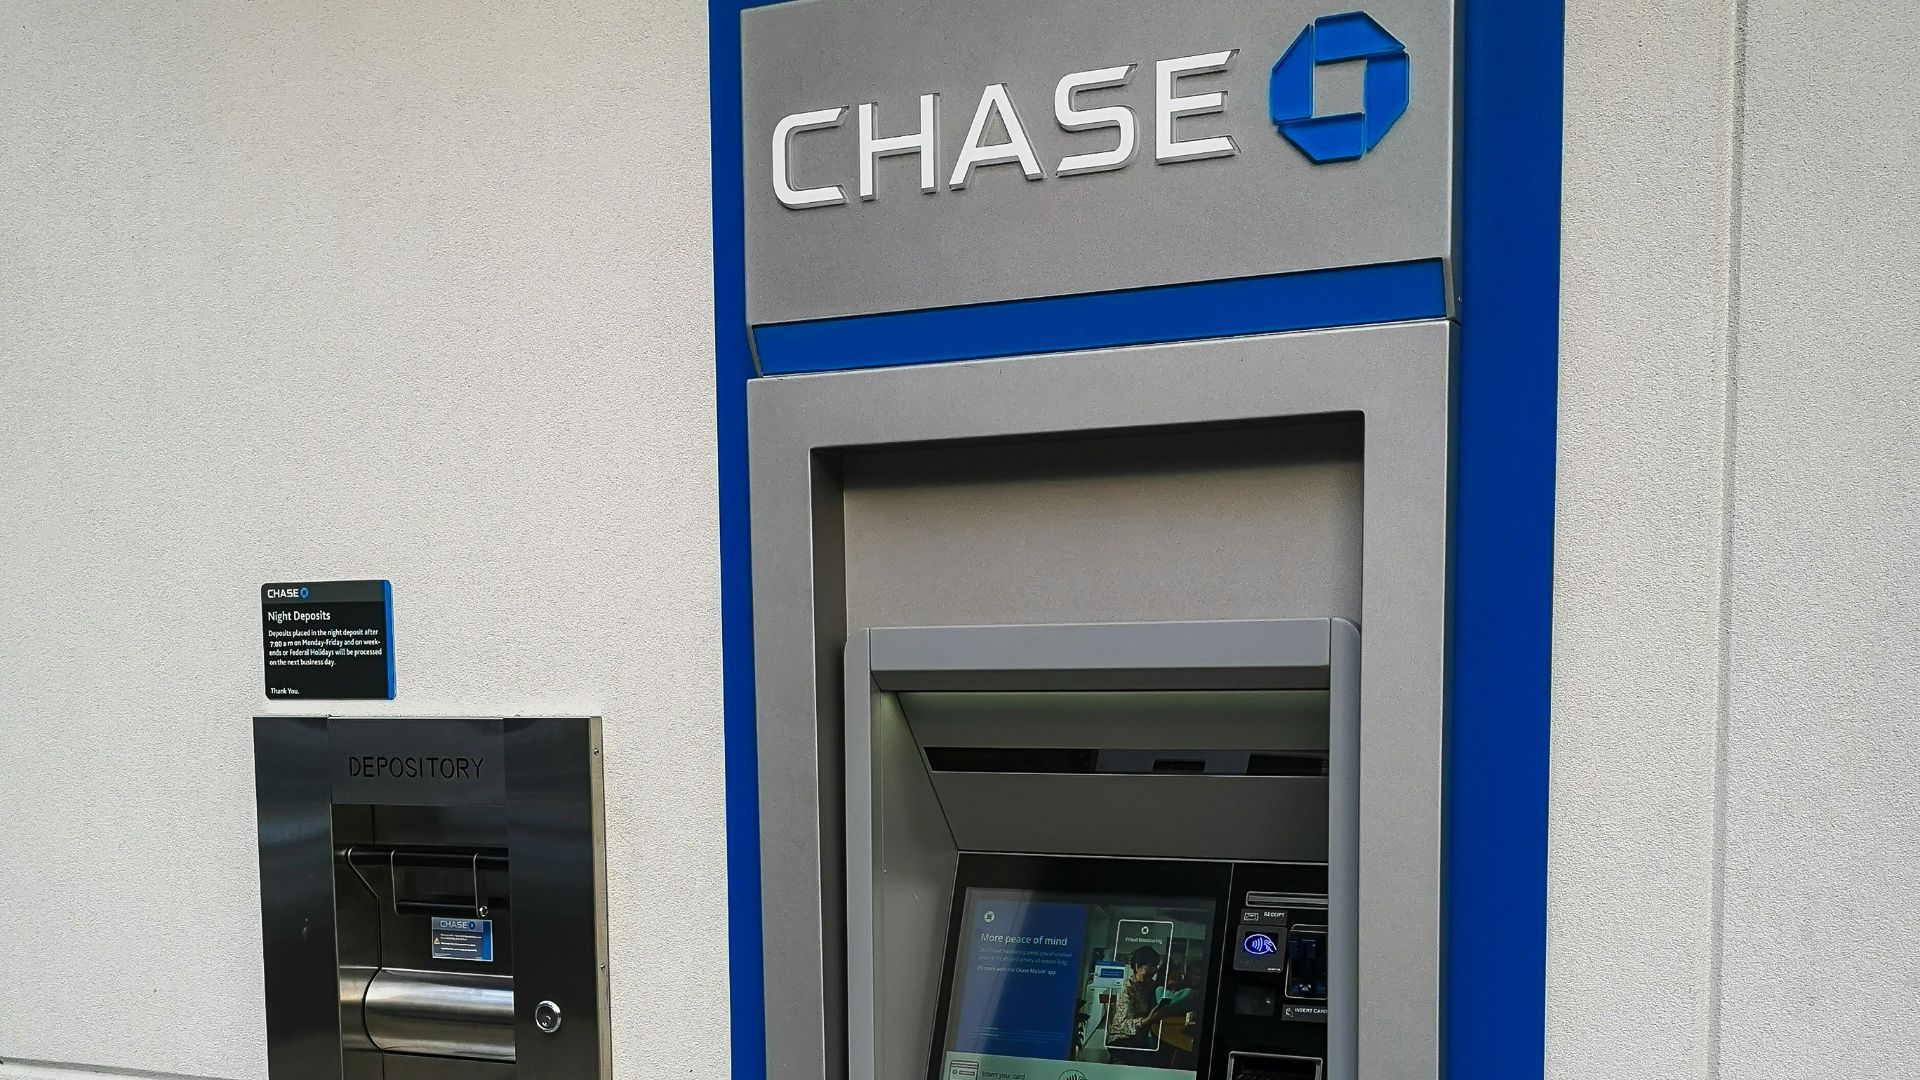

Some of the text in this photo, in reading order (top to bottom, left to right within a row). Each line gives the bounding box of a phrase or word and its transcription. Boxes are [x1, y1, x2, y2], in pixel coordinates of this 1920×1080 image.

[772, 49, 1240, 209] CHASE
[267, 588, 299, 598] CHASE
[267, 610, 331, 623] Night Deposits
[268, 628, 379, 638] Deposits placed in the night deposit after
[302, 638, 343, 648] Monday-Friday
[344, 638, 355, 646] and
[363, 638, 381, 646] week-
[269, 648, 282, 656] ends
[289, 648, 310, 656] Federal
[310, 648, 334, 658] Holidays
[335, 648, 346, 656] will
[346, 648, 354, 656] be
[354, 648, 383, 658] processed
[277, 658, 287, 666] the
[300, 658, 324, 666] business
[324, 658, 337, 667] day.
[271, 687, 287, 695] Thank
[349, 756, 484, 780] DEPOSITORY
[440, 920, 468, 929] CHASE
[980, 933, 1068, 946] More peace of mind
[998, 1072, 1012, 1080] your
[1013, 1072, 1026, 1080] card
